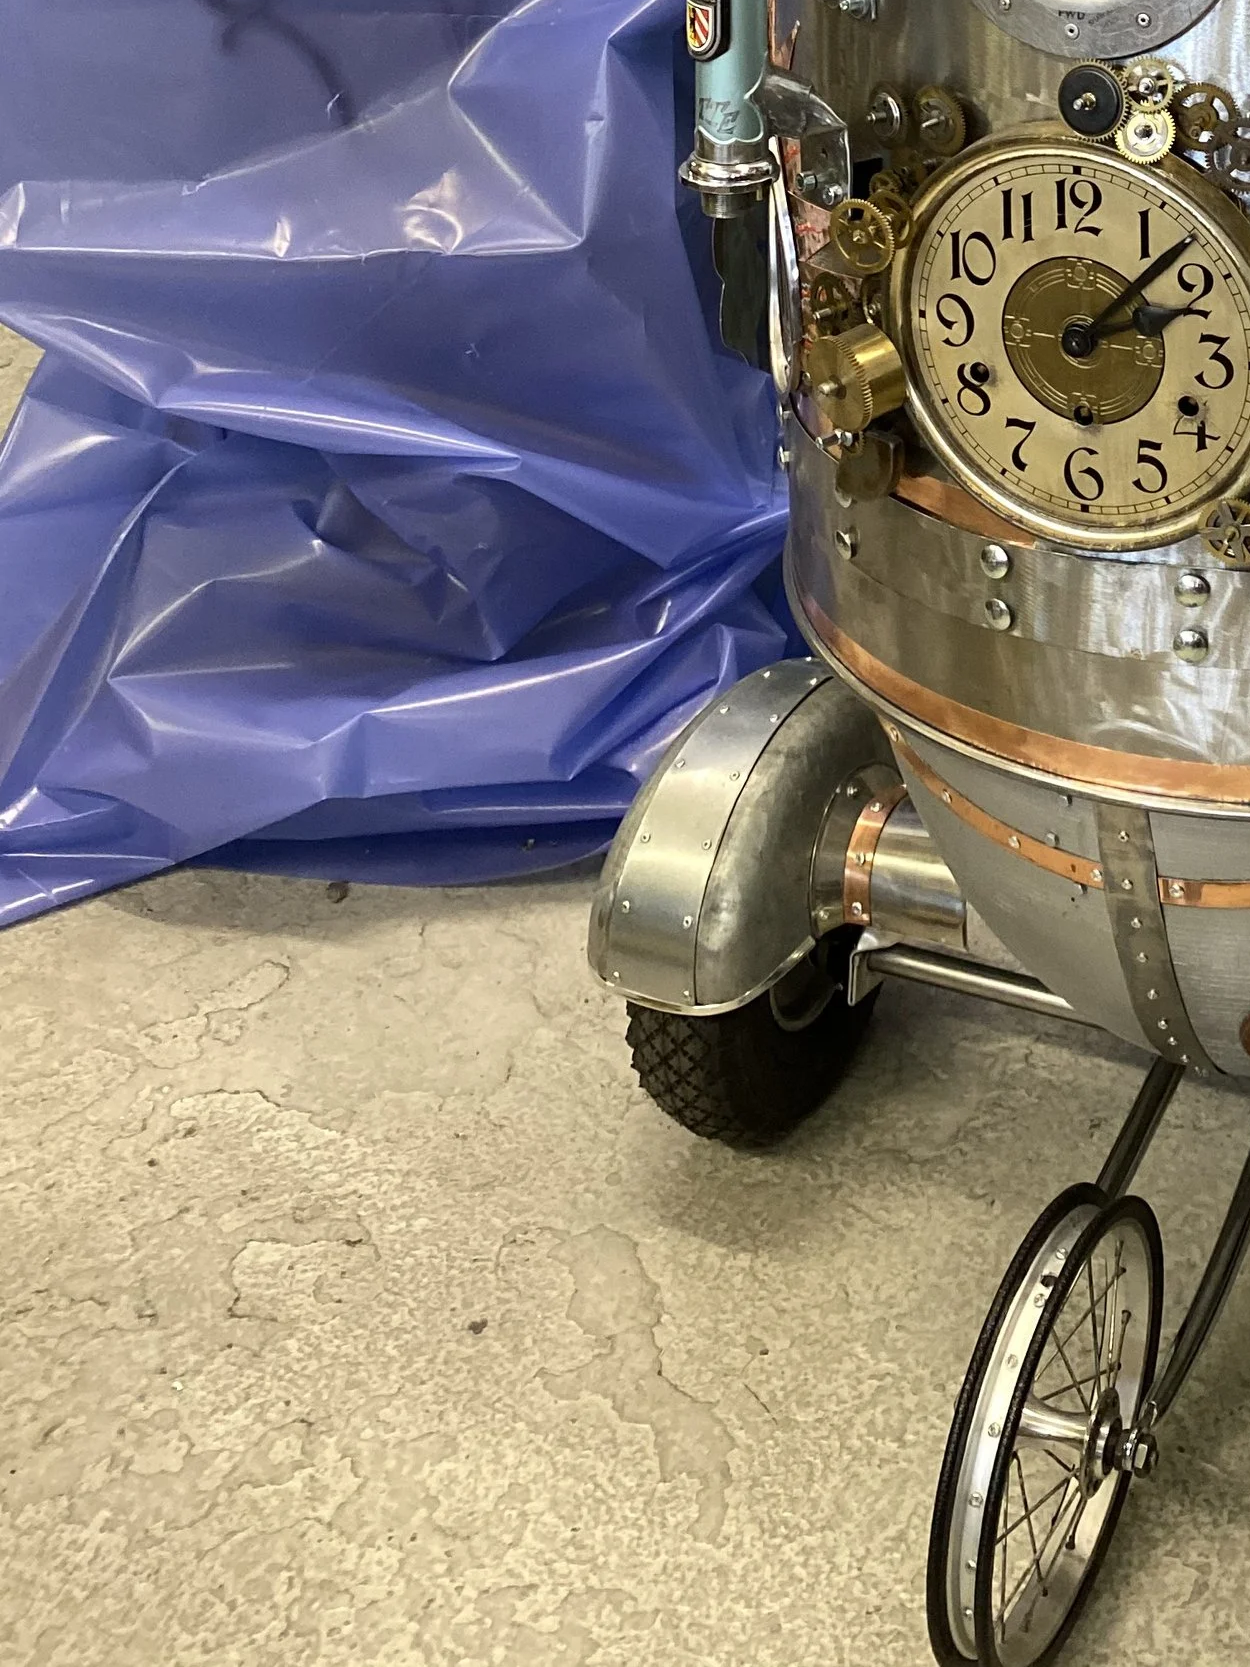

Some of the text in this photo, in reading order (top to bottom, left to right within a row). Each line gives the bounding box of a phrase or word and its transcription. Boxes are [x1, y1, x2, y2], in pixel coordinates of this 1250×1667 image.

[1058, 10, 1086, 21] FWD
[1001, 188, 1035, 243] 11
[1055, 178, 1103, 237] 12
[1138, 207, 1152, 261] 1
[950, 228, 997, 286] 10
[1177, 263, 1214, 320] 2
[936, 293, 975, 348] 9
[956, 362, 991, 416] 8
[1194, 332, 1235, 390] 3
[1004, 416, 1037, 473] 7
[1172, 402, 1222, 453] 4
[1063, 446, 1104, 502] 6
[1132, 438, 1168, 494] 5
